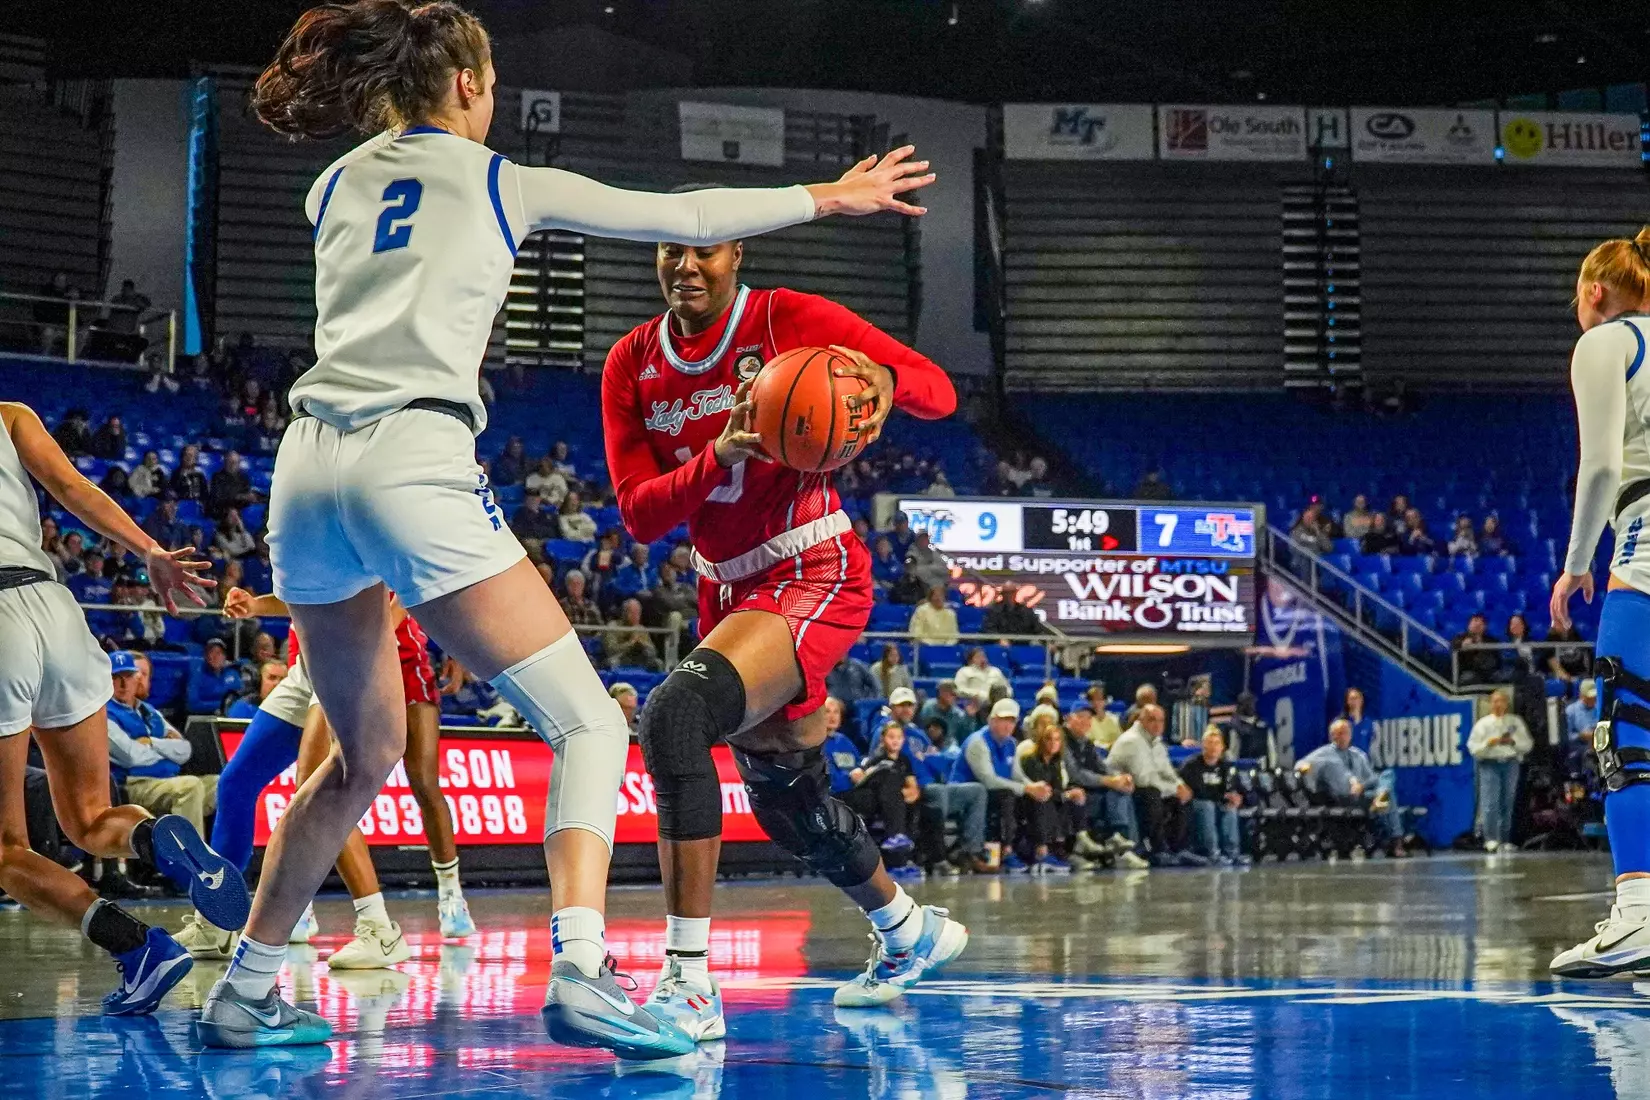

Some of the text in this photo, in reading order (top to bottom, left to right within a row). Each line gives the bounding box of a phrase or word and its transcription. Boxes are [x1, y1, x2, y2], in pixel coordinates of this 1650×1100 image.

[530, 98, 552, 121] G
[1317, 114, 1339, 139] H
[1547, 123, 1640, 151] Hiller
[372, 177, 424, 255] 2
[638, 371, 661, 381] adidas
[644, 398, 687, 437] Lady
[978, 511, 997, 541] 9
[1052, 510, 1109, 535] 5:49
[1155, 513, 1179, 546] 7
[1069, 536, 1092, 551] 1st
[1009, 555, 1128, 574] Supporter
[1131, 556, 1157, 573] of
[1160, 560, 1230, 575] MTSU
[1063, 573, 1239, 603] WILSON
[1058, 600, 1132, 621] Bank
[1176, 602, 1246, 622] Trust
[1370, 713, 1463, 770] RUEBLUE
